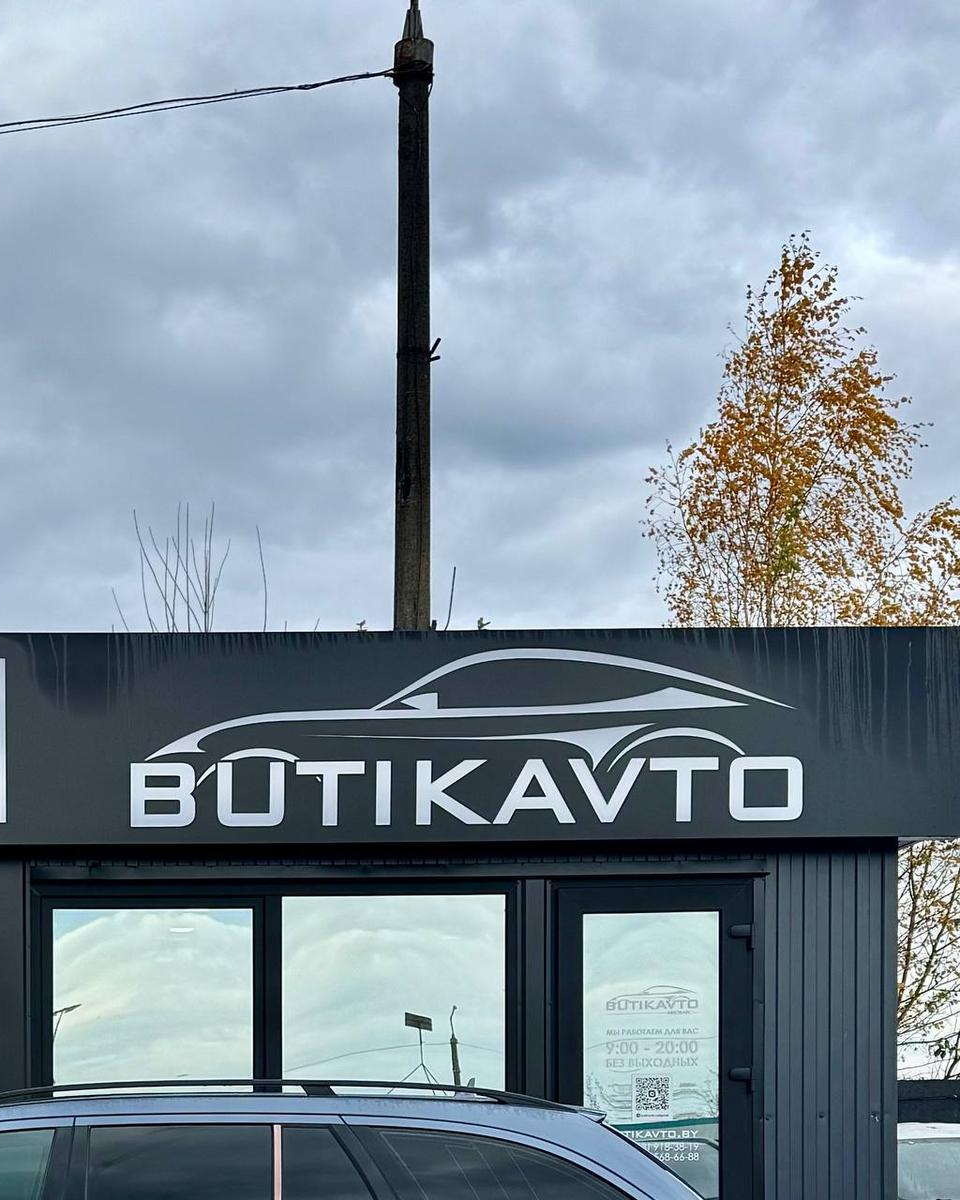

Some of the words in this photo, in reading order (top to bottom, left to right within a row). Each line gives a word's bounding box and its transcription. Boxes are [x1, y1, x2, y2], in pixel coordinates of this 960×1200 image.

[130, 755, 804, 828] BUTIKAVTO
[606, 1000, 698, 1011] BUTIKAVTO
[622, 1028, 663, 1036] РАБОТАЕМ
[664, 1028, 681, 1036] ДЛЯ
[606, 1041, 639, 1055] 9:00
[655, 1040, 698, 1054] 20:00
[606, 1058, 625, 1068] БЕЗ
[628, 1057, 698, 1068] ВЫХОДНЫХ
[623, 1130, 699, 1138] TIKAVTO.BY
[654, 1143, 700, 1151] 918-38-19
